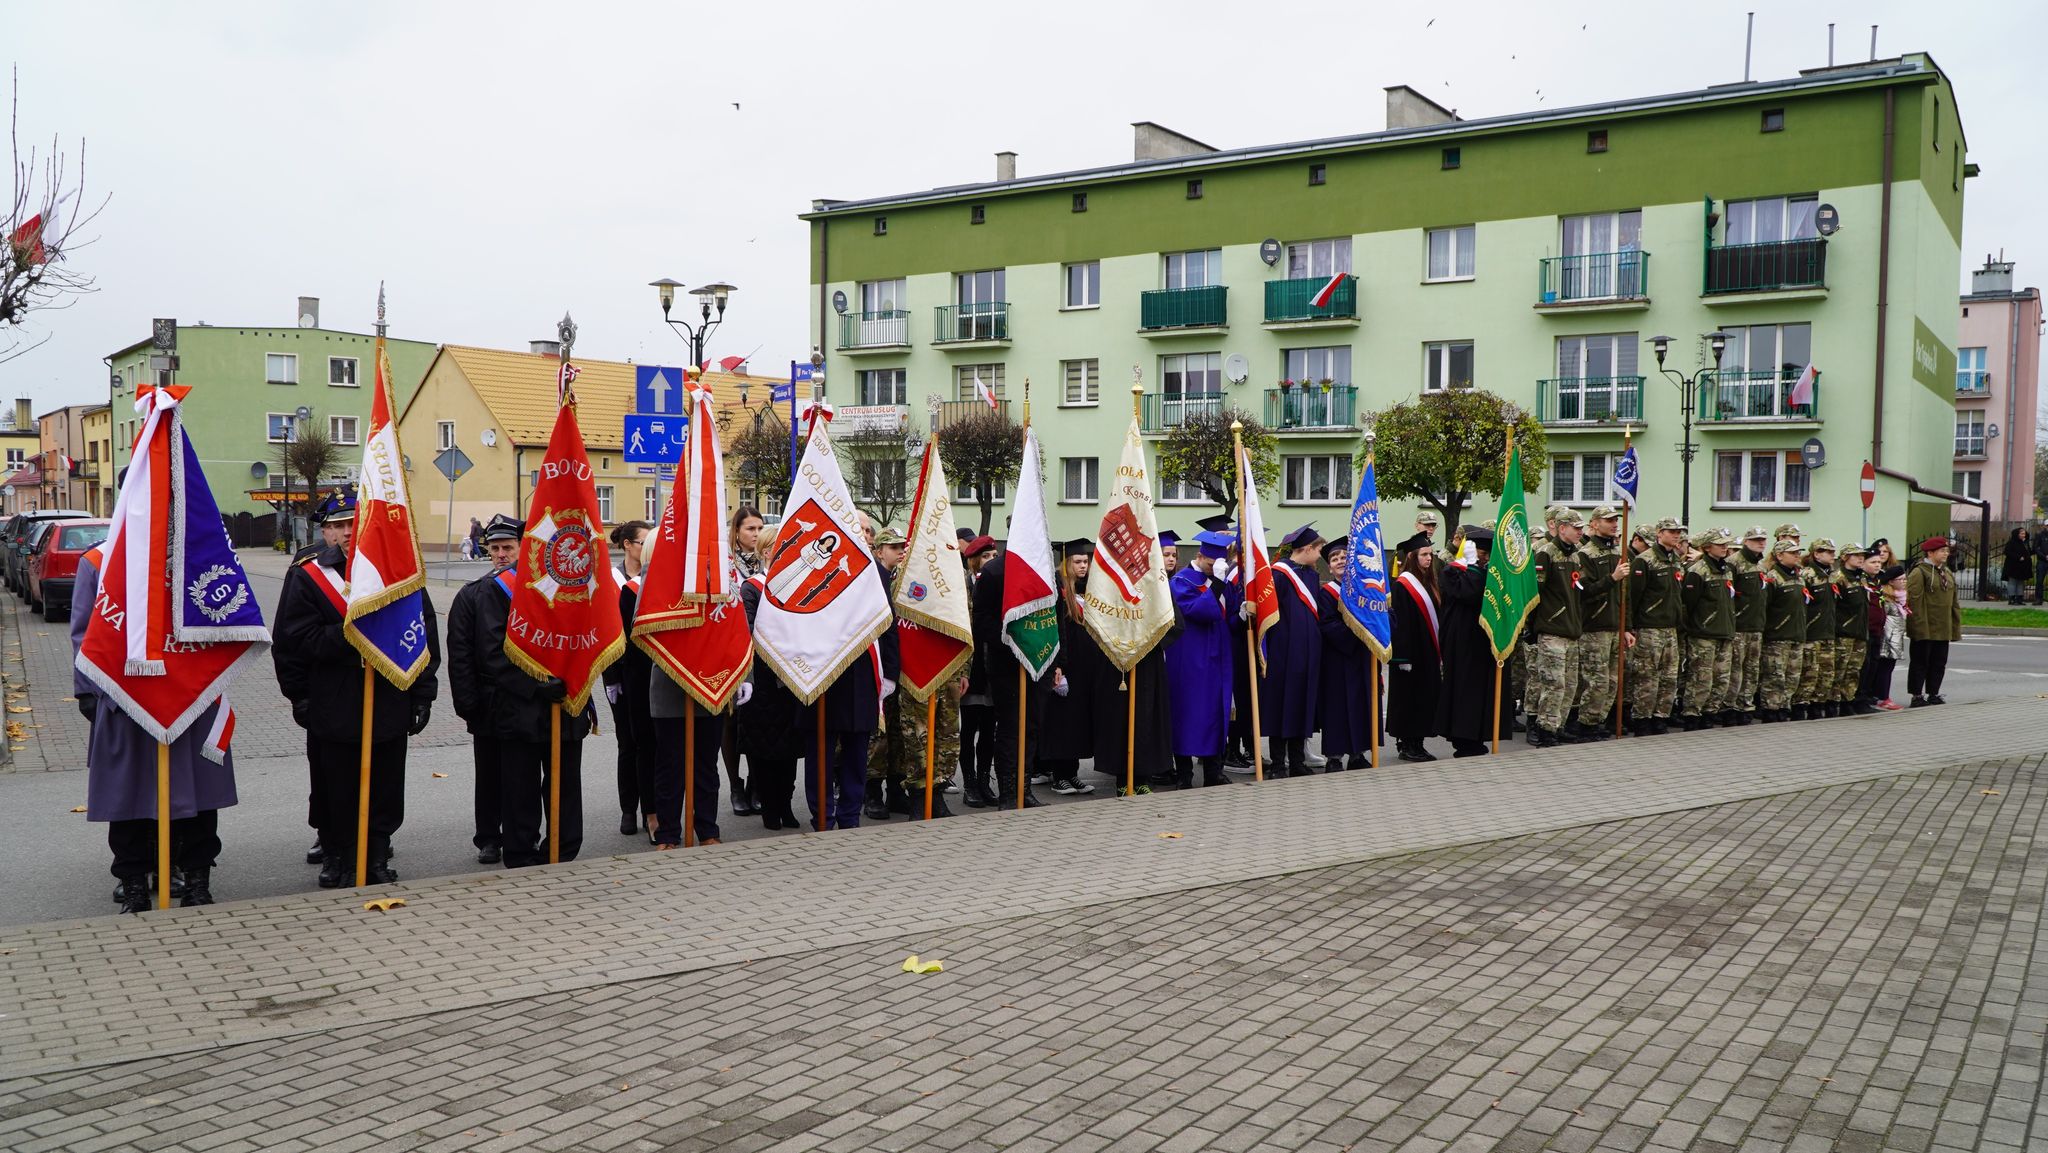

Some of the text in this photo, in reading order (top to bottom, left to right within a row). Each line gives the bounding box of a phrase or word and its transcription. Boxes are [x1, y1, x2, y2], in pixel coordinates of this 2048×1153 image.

[841, 407, 872, 415] CENTRUM
[814, 436, 830, 457] 1300
[1116, 465, 1144, 480] KOŁA
[664, 493, 676, 543] OWIAT
[924, 543, 951, 598] ZESPÓŁ
[1084, 592, 1144, 620] OBRZYNIU
[508, 608, 529, 639] NA
[897, 618, 918, 631] NA
[1040, 616, 1057, 629] FRY
[163, 633, 214, 653] RAW
